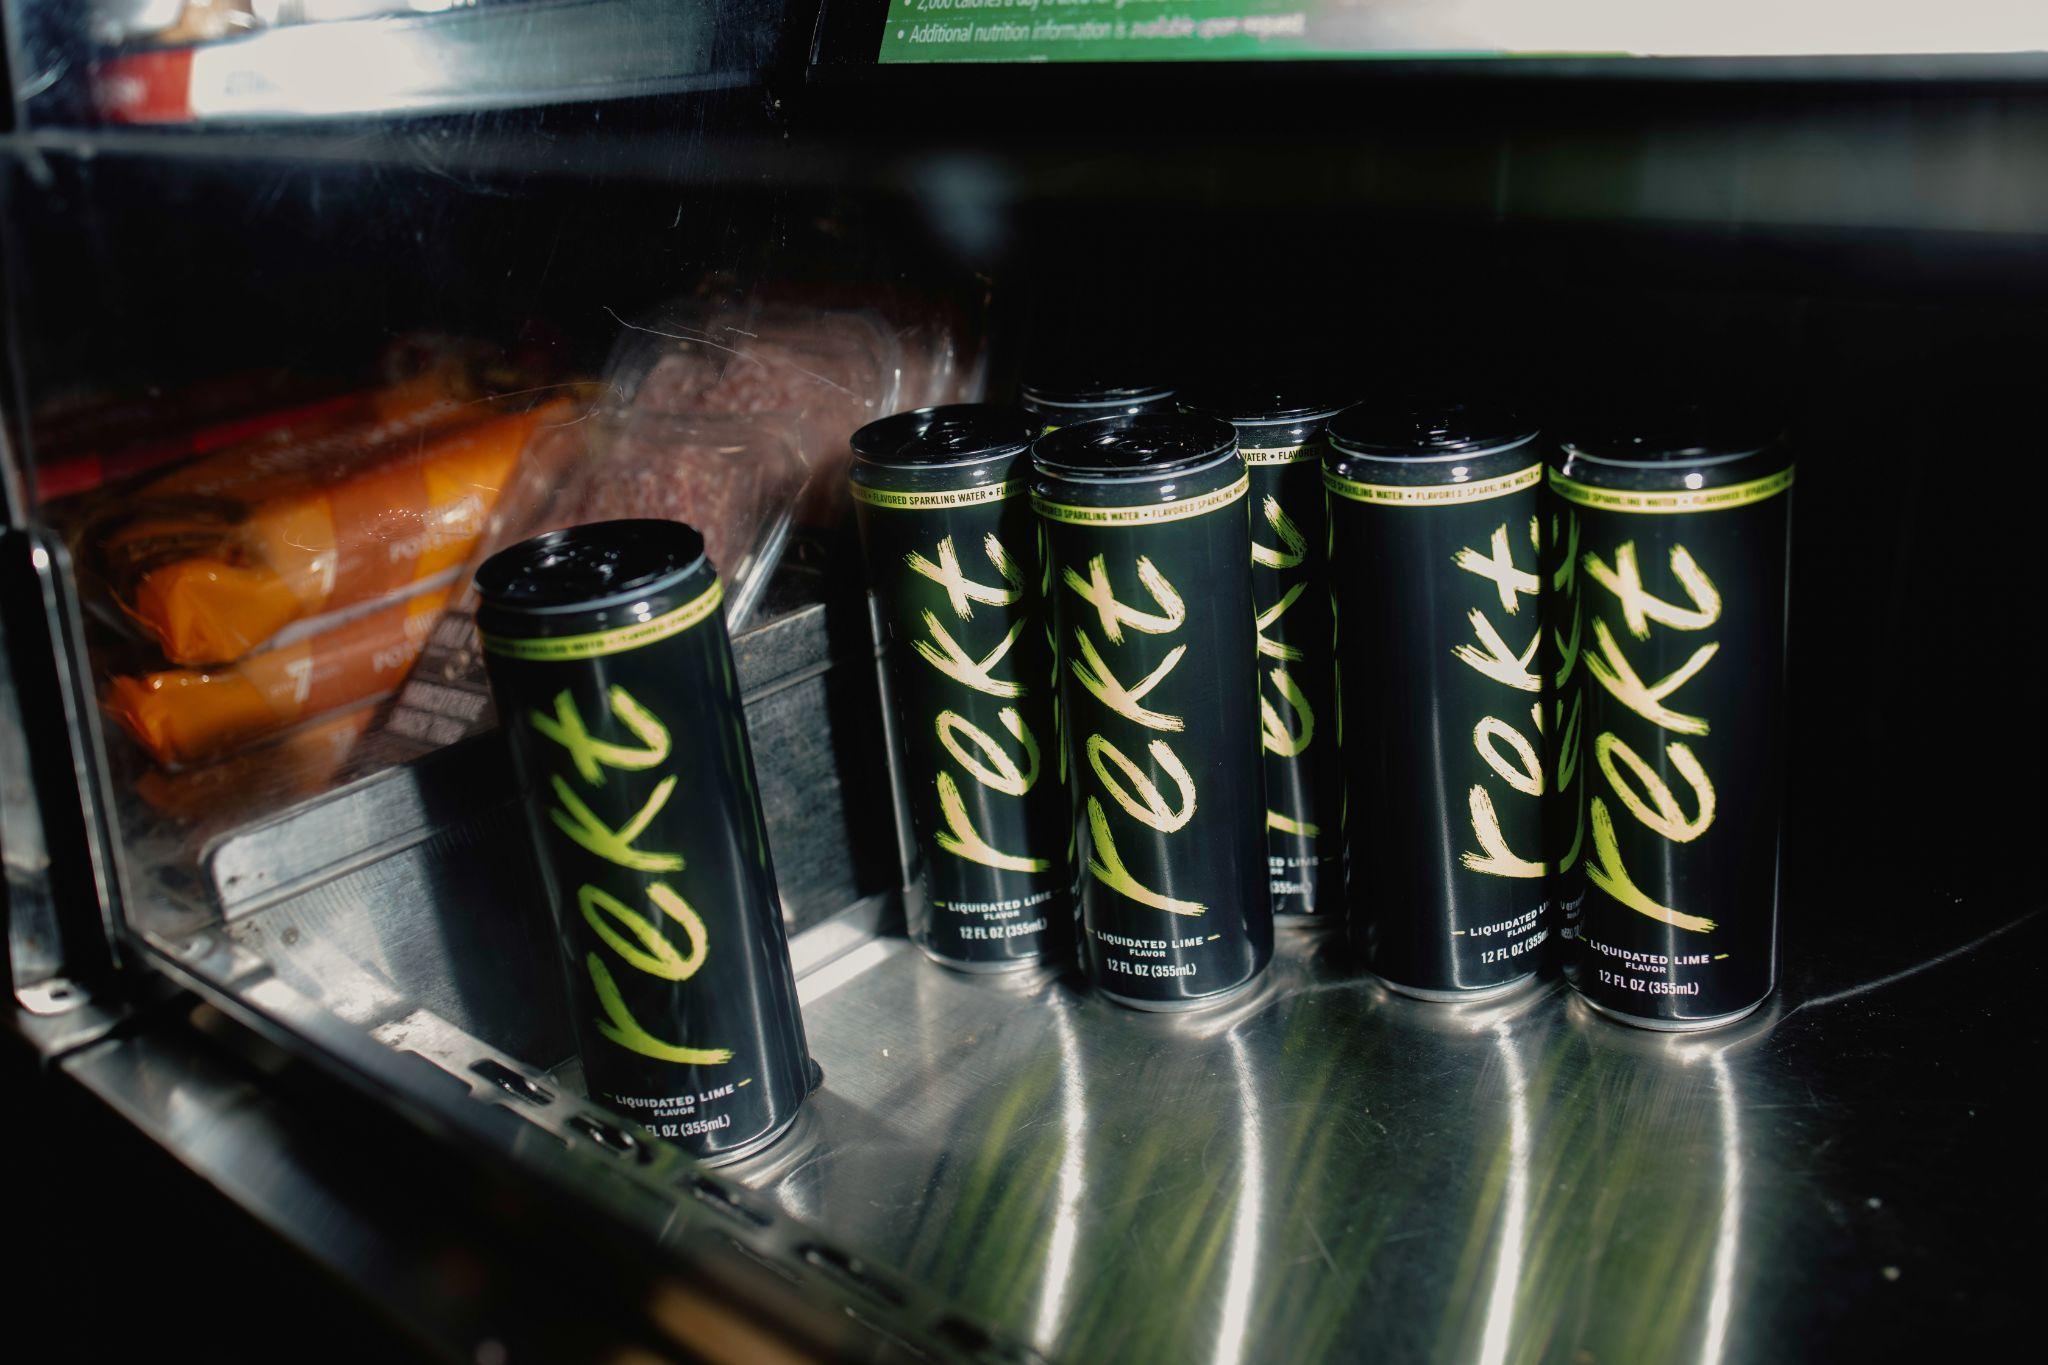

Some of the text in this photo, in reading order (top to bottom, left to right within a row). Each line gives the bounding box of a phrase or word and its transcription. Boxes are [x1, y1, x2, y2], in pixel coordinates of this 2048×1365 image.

[909, 23, 973, 43] Additional
[974, 22, 1030, 41] nutrition
[1033, 19, 1110, 40] information
[1115, 20, 1125, 38] is
[873, 493, 907, 505] FLAVORED
[909, 495, 956, 505] SPARKLING
[958, 490, 986, 504] WATER
[1377, 491, 1402, 499] WATER
[1064, 509, 1107, 520] SPARKLING
[1111, 511, 1139, 520] WATER
[1152, 503, 1195, 517] FLAVORED
[1199, 493, 1233, 509] SPARKLING
[948, 891, 1051, 914] LIQUIDATED LIME
[983, 910, 1020, 921] FLAVOR
[1470, 909, 1537, 937] LIQUIDATED
[959, 917, 1048, 939] 12 FL OZ (355mL)
[1507, 920, 1536, 938] FLAVOR
[1097, 930, 1204, 949] LIQUIDATED LIME
[1129, 948, 1166, 958] FLAVOR
[1481, 950, 1494, 964] 12
[1497, 947, 1509, 961] FL
[1511, 942, 1524, 957] OZ
[1590, 939, 1710, 965] LIQUIDATED LIME
[1107, 958, 1197, 978] 12 FL OZ (355mL)
[1625, 961, 1666, 974] FLAVOR
[1599, 969, 1699, 996] 12 FL OZ (355mL)
[616, 1084, 734, 1109] LIQUIDATED LIME
[654, 1106, 695, 1117] FLAVOR
[646, 1125, 660, 1137] FL
[662, 1124, 678, 1137] OZ
[681, 1114, 731, 1138] (355mL)
